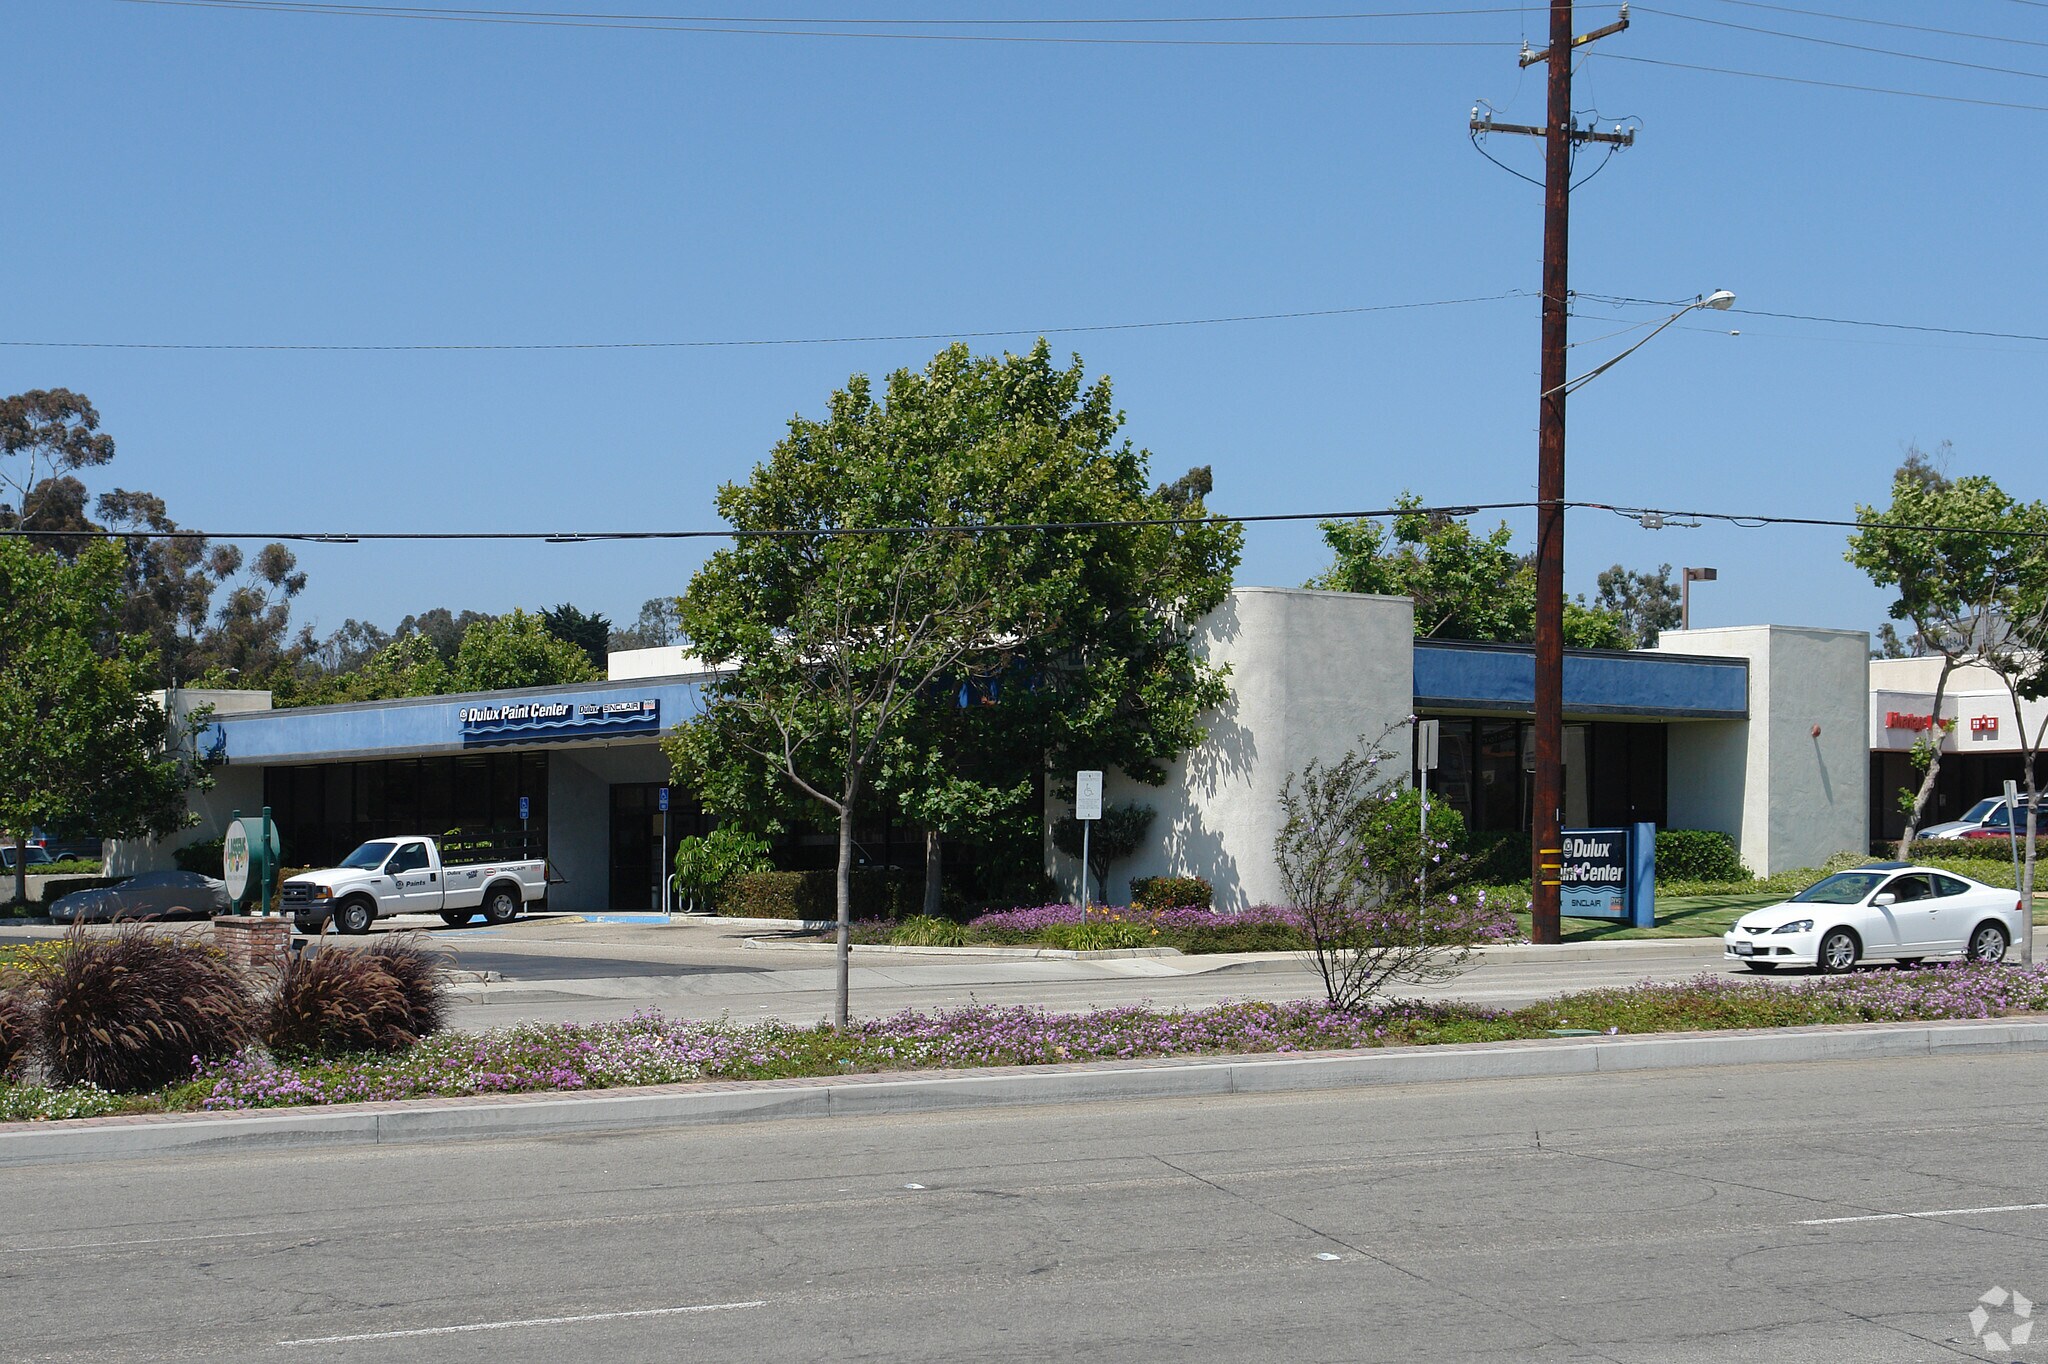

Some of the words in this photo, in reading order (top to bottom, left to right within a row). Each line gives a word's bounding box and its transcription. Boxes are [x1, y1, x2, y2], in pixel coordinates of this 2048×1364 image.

[468, 706, 500, 722] Dulux
[501, 704, 529, 720] Paint
[530, 702, 568, 718] Center
[602, 702, 640, 713] SINCLAIR
[1573, 838, 1610, 858] Dulux
[1581, 861, 1624, 881] Center
[405, 880, 426, 888] Paints
[1571, 899, 1602, 907] SINCLAIR
